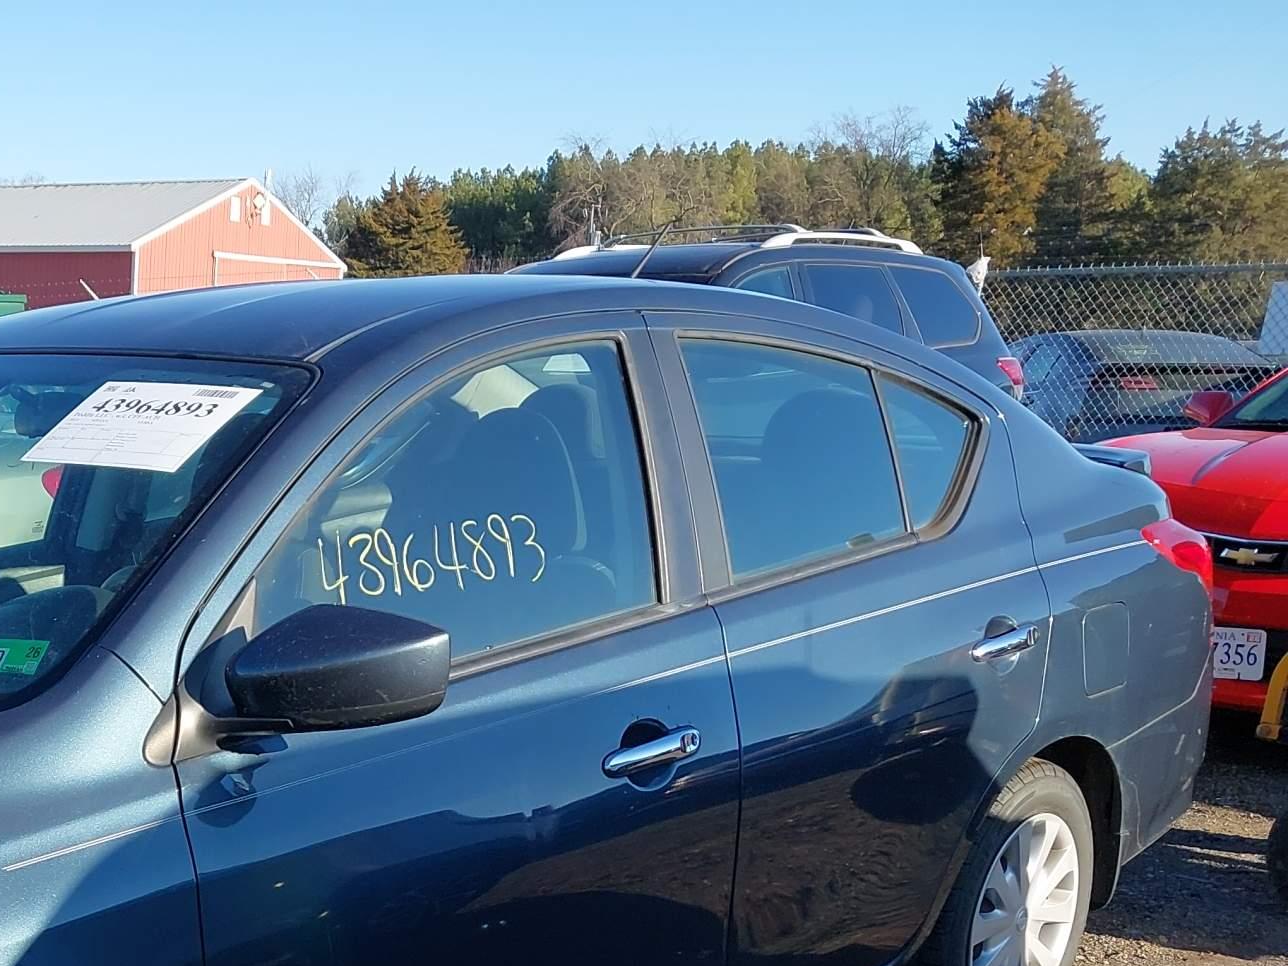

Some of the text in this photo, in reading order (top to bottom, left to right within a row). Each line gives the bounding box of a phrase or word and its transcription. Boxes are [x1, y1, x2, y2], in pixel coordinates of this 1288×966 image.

[92, 398, 220, 418] 43964893
[317, 513, 546, 606] 43964893
[1215, 631, 1236, 641] NIA
[25, 646, 42, 659] 26
